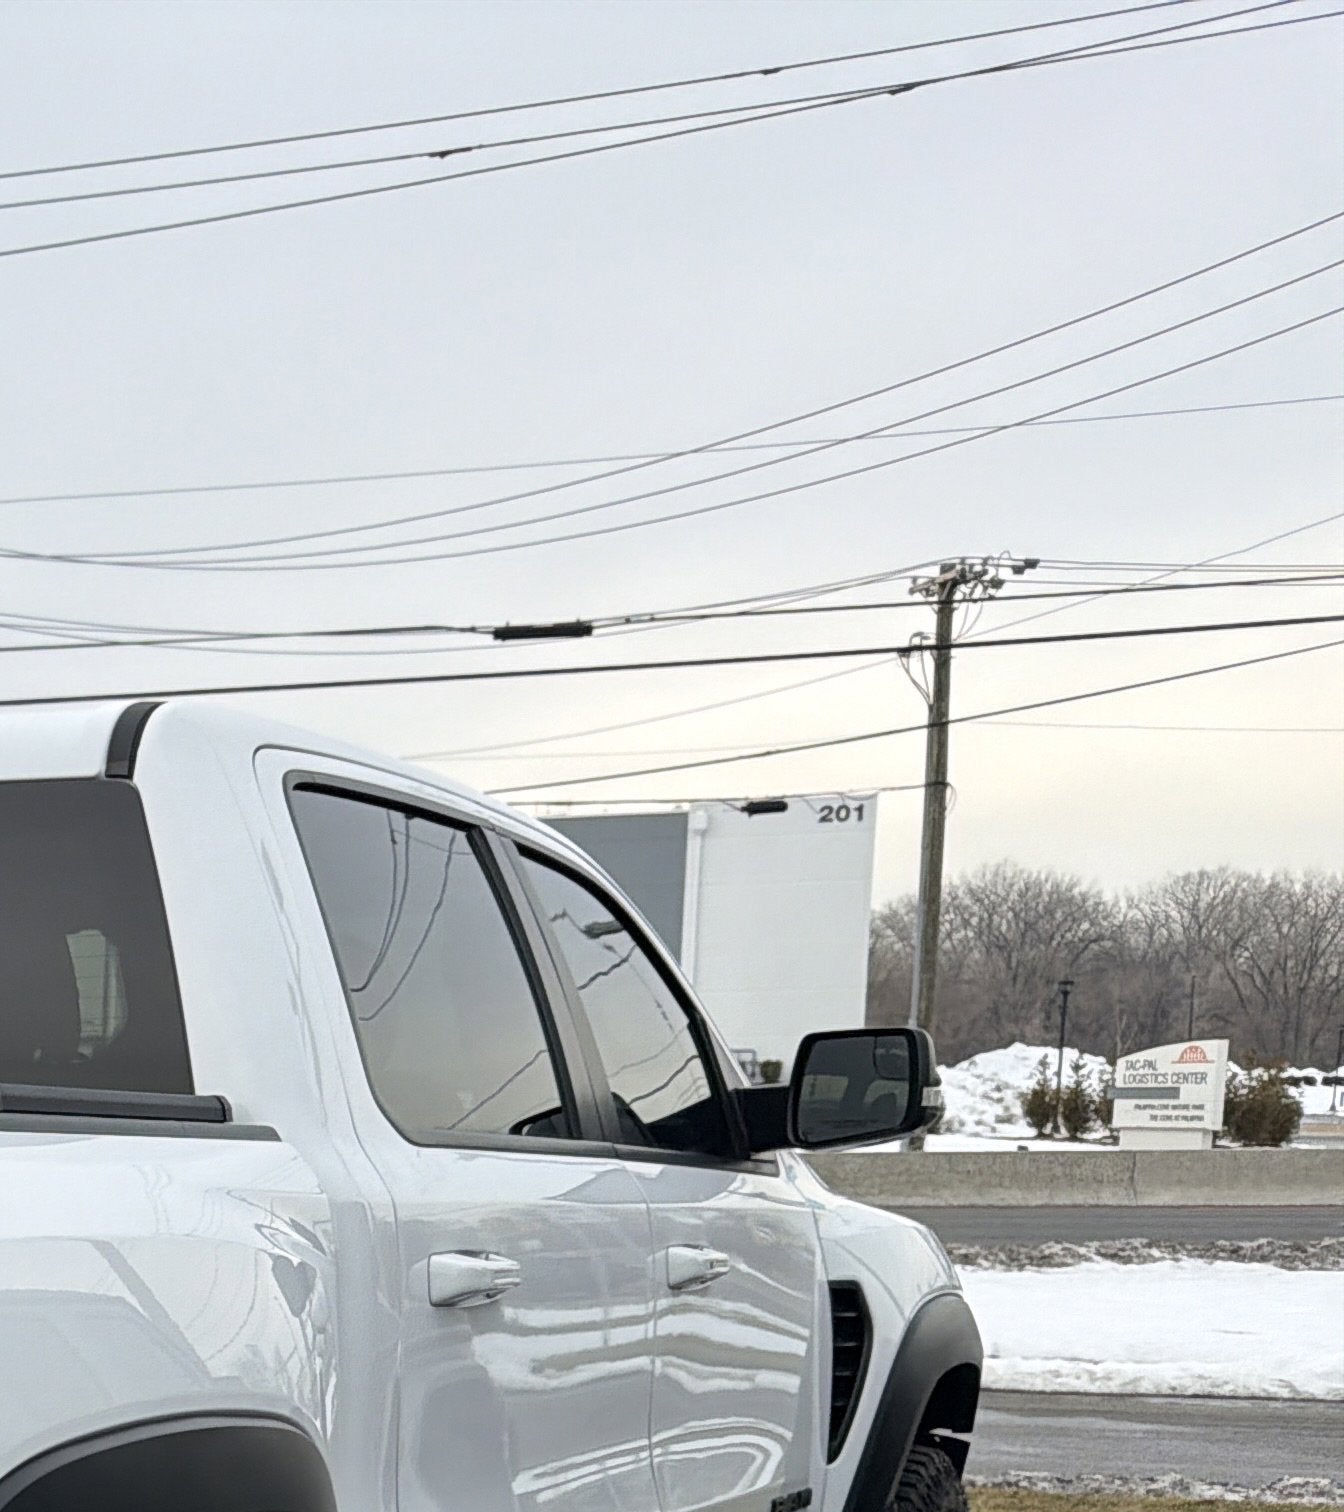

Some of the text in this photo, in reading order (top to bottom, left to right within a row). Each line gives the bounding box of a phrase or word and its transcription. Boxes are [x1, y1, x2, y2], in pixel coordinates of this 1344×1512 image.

[818, 803, 864, 823] 201
[1123, 1071, 1208, 1085] LOGISTICS CENTER
